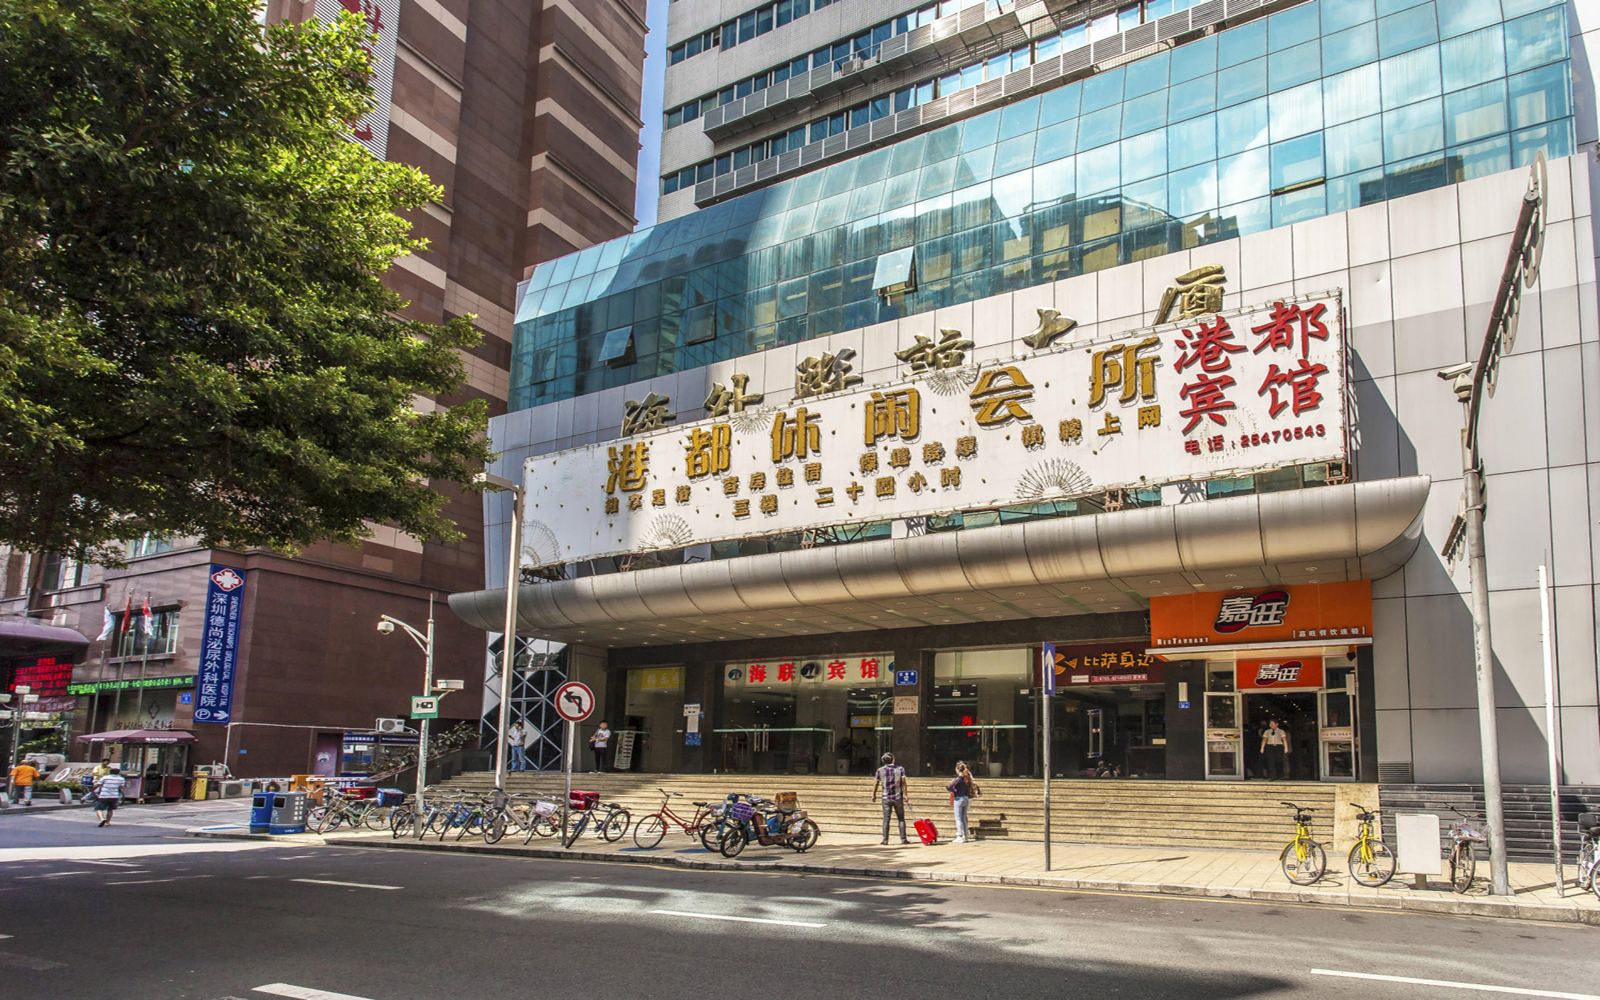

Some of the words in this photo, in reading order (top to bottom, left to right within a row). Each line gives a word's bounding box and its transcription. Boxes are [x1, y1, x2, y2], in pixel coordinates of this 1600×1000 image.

[1174, 302, 1329, 374] 港都
[606, 336, 1161, 494] 港都休闲会所
[1179, 359, 1328, 436] 宾馆
[722, 462, 822, 494] 客房住宿
[732, 493, 778, 517] 三楼
[815, 465, 962, 503] 二十四小时
[1217, 596, 1286, 625] 嘉旺
[200, 592, 228, 707] 深圳德尚泌尿外科医院
[1084, 651, 1154, 668] 比萨身边
[1258, 663, 1301, 682] 嘉旺
[219, 682, 229, 707] HOSPITAL
